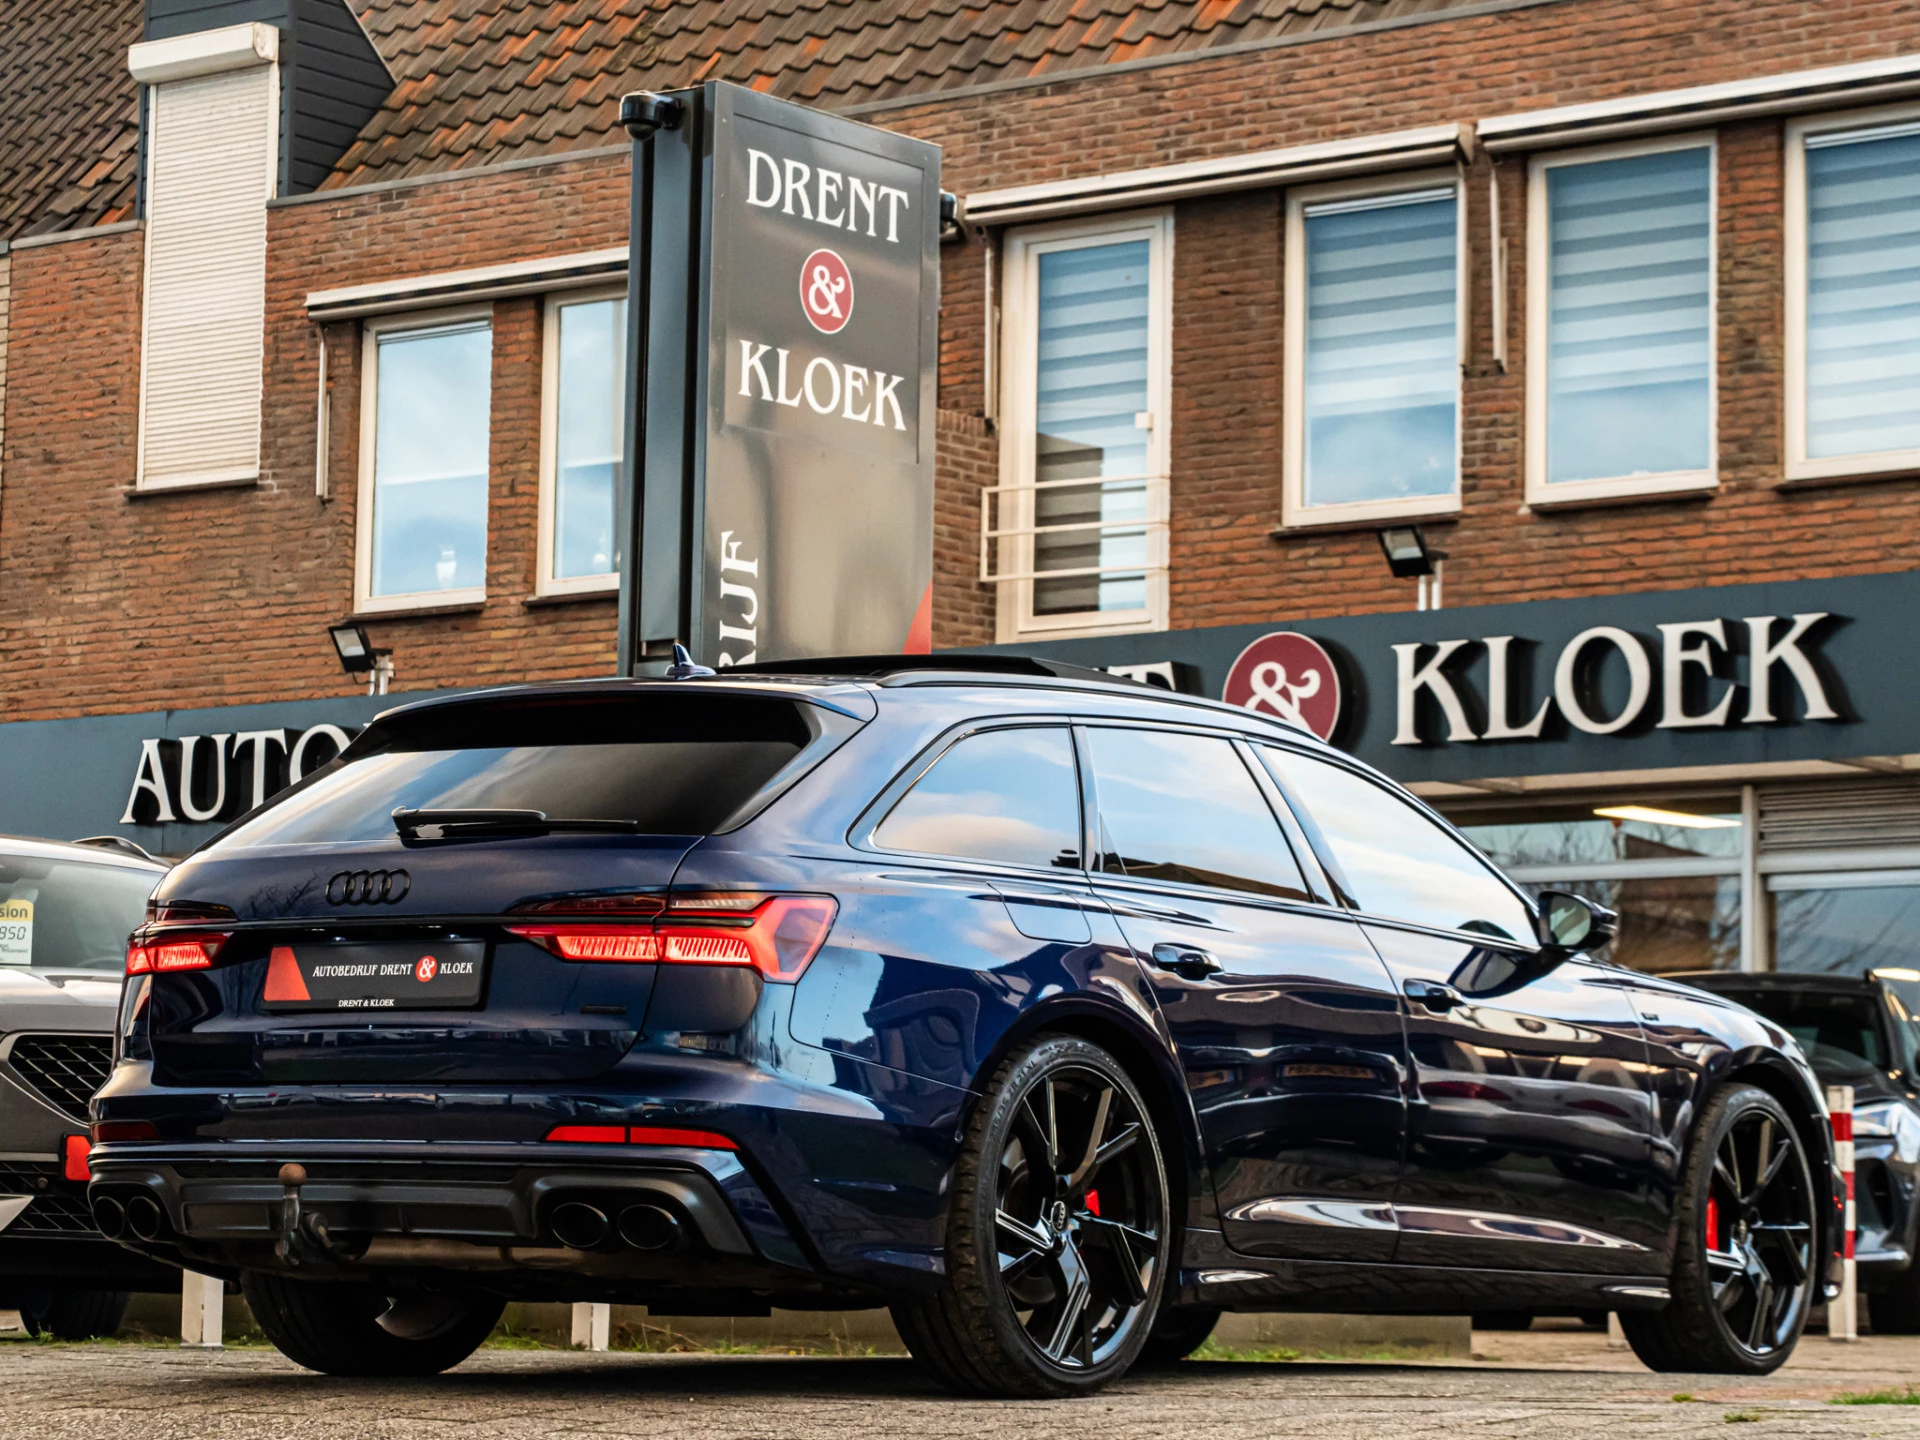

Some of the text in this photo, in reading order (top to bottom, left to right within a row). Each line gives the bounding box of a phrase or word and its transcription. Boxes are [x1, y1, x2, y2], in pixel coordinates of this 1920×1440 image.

[746, 148, 909, 243] DRENT
[808, 265, 846, 319] &
[738, 339, 907, 431] KLOEK
[1391, 612, 1839, 746] KLOEK
[119, 722, 373, 824] AUTO
[312, 958, 473, 979] AUTOBEDRIJF DRENT & KLOEK
[370, 999, 395, 1007] KLOEK
